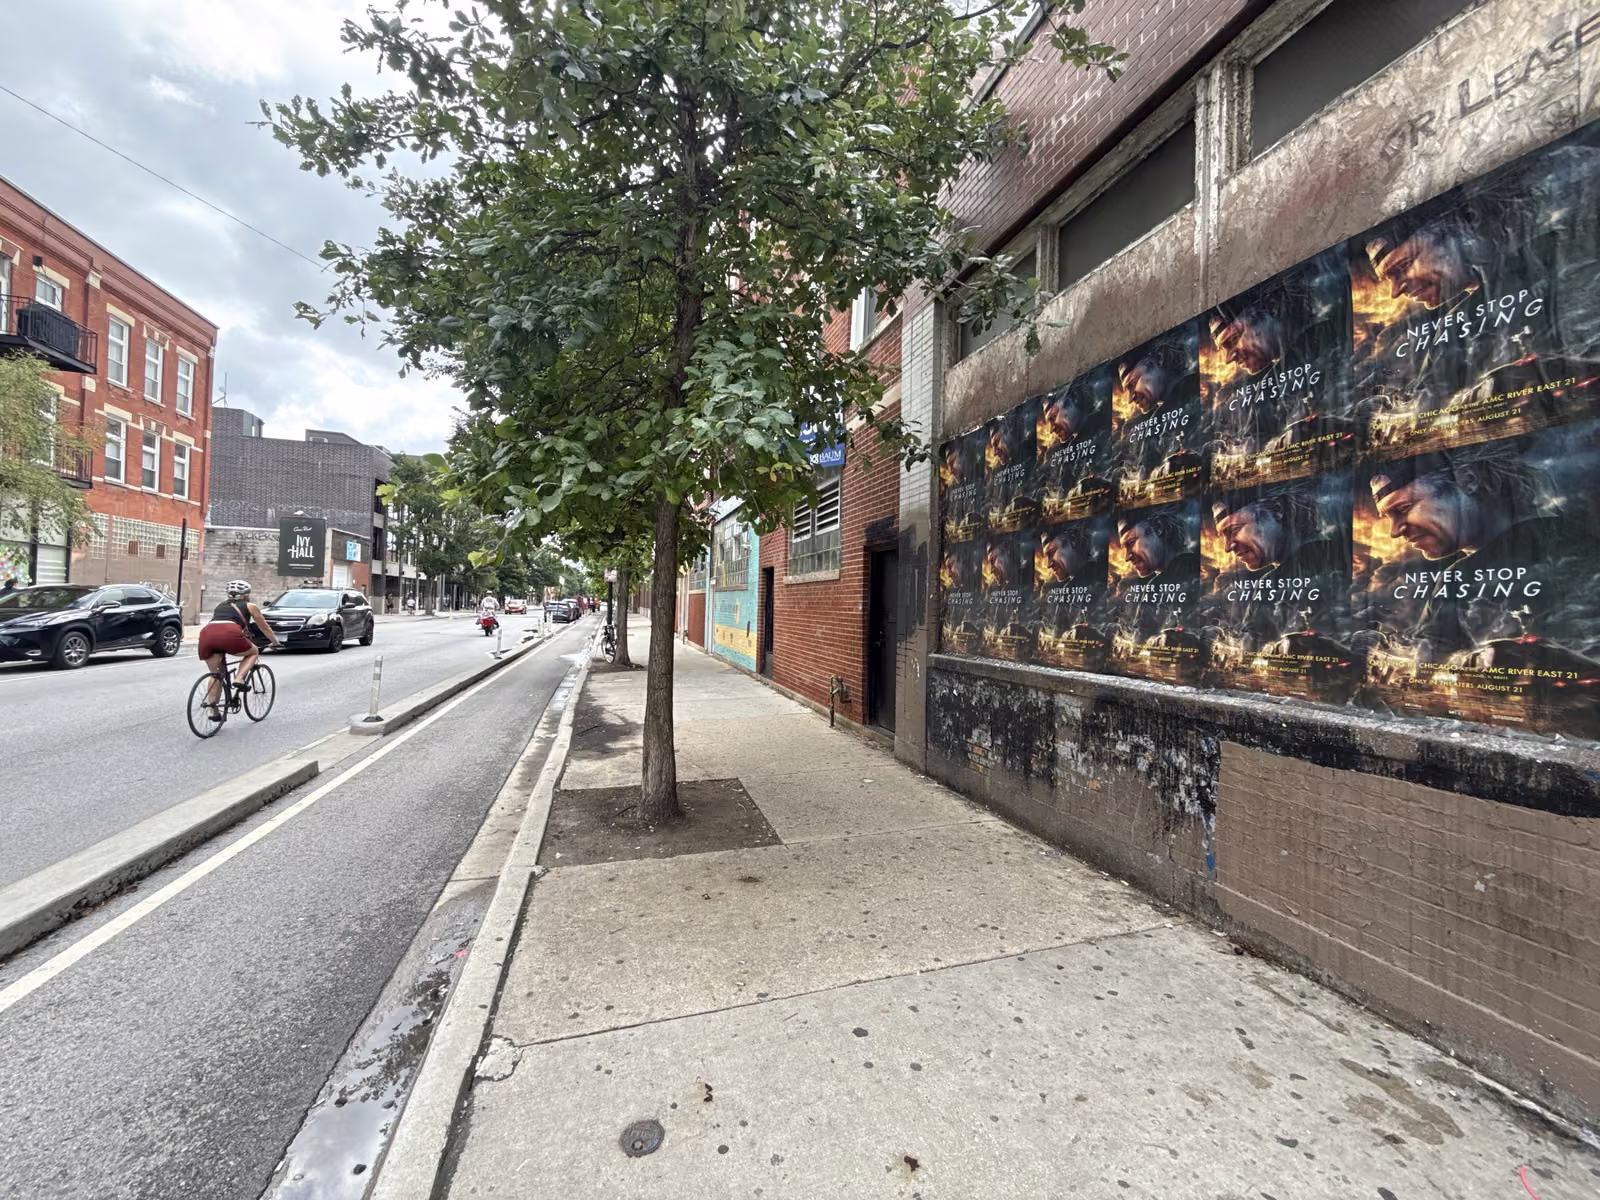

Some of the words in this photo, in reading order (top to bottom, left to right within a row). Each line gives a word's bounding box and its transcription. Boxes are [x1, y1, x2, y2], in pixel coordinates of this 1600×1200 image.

[1457, 11, 1600, 119] LEASE
[1406, 312, 1465, 339] NEVER
[1476, 289, 1528, 316] STOP
[1396, 298, 1544, 358] CHASING
[1236, 376, 1273, 397] NEVER
[1280, 364, 1312, 383] STOP
[1228, 372, 1321, 411] CHASING
[1418, 405, 1459, 419] CHICAGO
[1482, 394, 1504, 404] AMC
[1507, 388, 1534, 399] RIVER
[1537, 380, 1562, 392] EAST
[1564, 378, 1576, 386] 21
[1134, 416, 1158, 432] NEVER
[1162, 408, 1184, 422] STOP
[1477, 410, 1510, 422] AUGUST
[1129, 414, 1189, 443] CHASING
[1051, 445, 1096, 467] CHASING
[1054, 446, 1073, 457] NEVER
[1076, 439, 1092, 450] STOP
[296, 534, 310, 547] IVY
[288, 544, 315, 558] HALL
[1234, 579, 1272, 590] NEVER
[1278, 578, 1311, 588] STOP
[1405, 570, 1463, 584] NEVER
[1474, 567, 1528, 582] STOP
[1159, 584, 1180, 592] STOP
[1227, 588, 1320, 601] CHASING
[1393, 580, 1542, 600] CHASING
[1047, 594, 1092, 604] CHASING
[1125, 593, 1187, 603] CHASING
[1418, 662, 1458, 671] CHICAGO
[1508, 668, 1534, 676] RIVER
[1537, 670, 1563, 678] EAST
